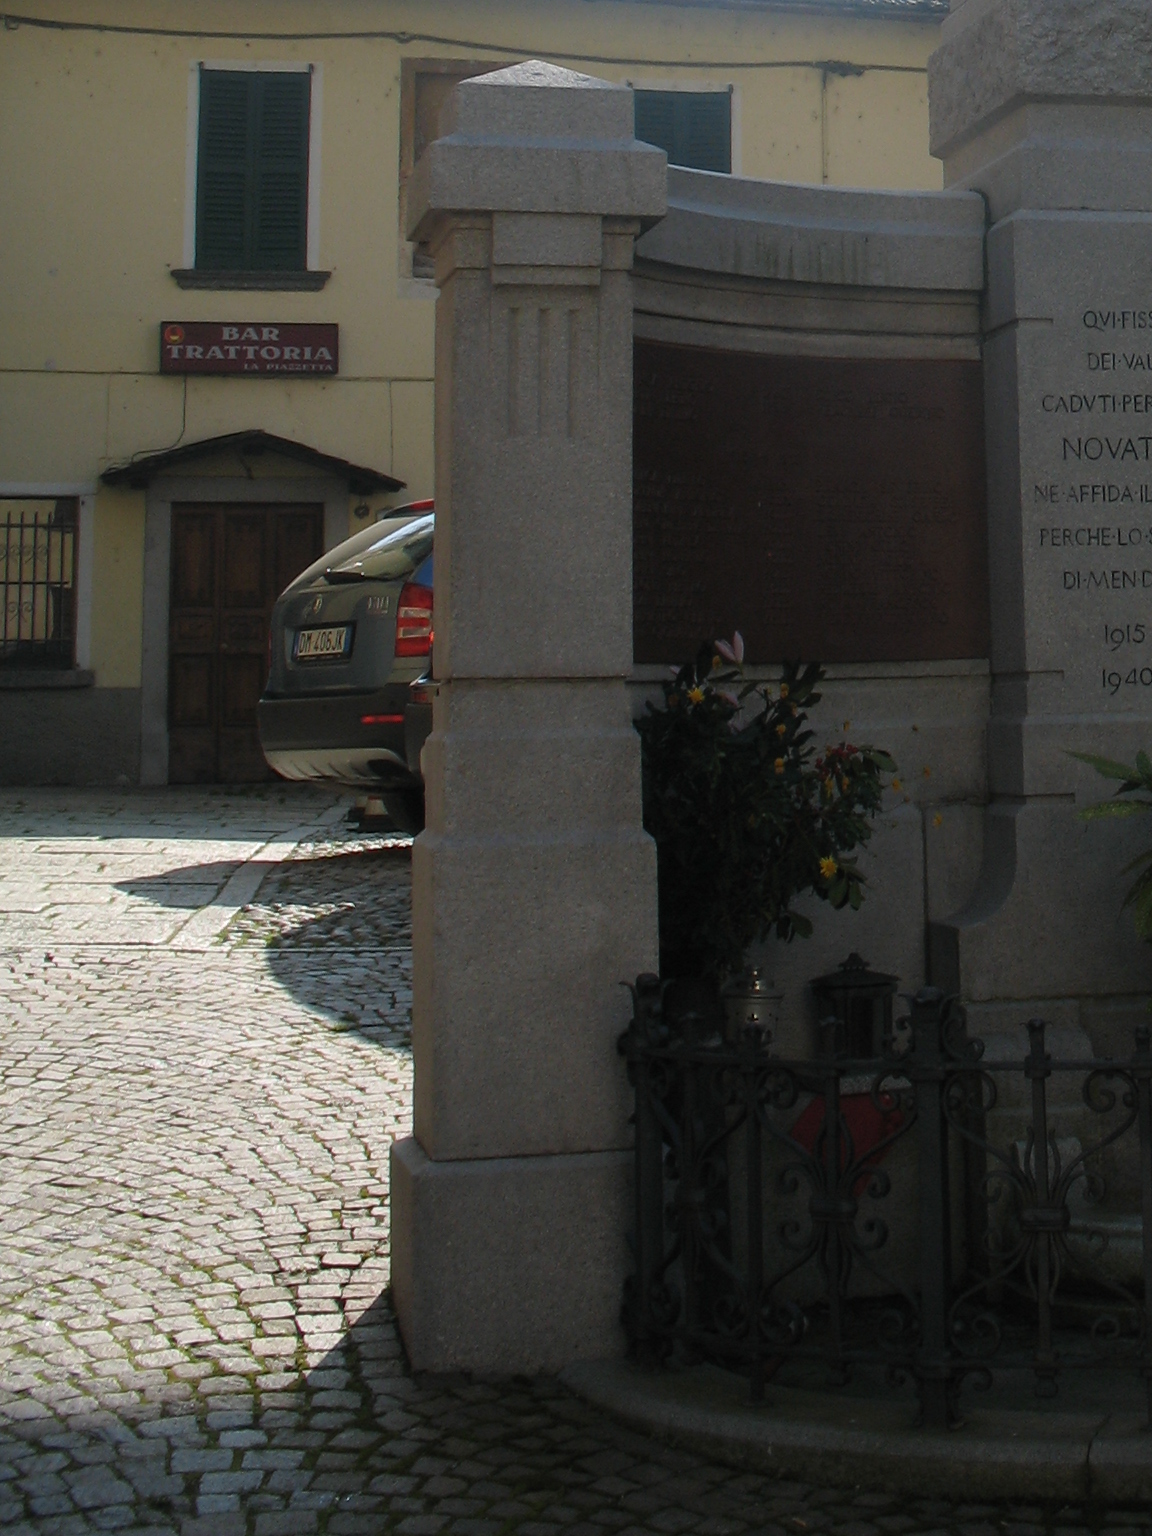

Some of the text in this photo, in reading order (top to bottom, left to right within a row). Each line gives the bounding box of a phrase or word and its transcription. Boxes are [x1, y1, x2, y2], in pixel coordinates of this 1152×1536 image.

[1083, 311, 1116, 332] QVI
[222, 327, 280, 341] BAR
[167, 345, 333, 360] TRATTORIA
[1088, 353, 1116, 370] DEI
[1042, 395, 1117, 413] CADVTI
[1067, 485, 1133, 503] AFFIDA
[1040, 528, 1110, 546] PERCHE
[1117, 528, 1142, 546] LO
[1086, 570, 1136, 589] MEN
[298, 628, 344, 654] DM 406JK
[1104, 625, 1145, 651] 1915
